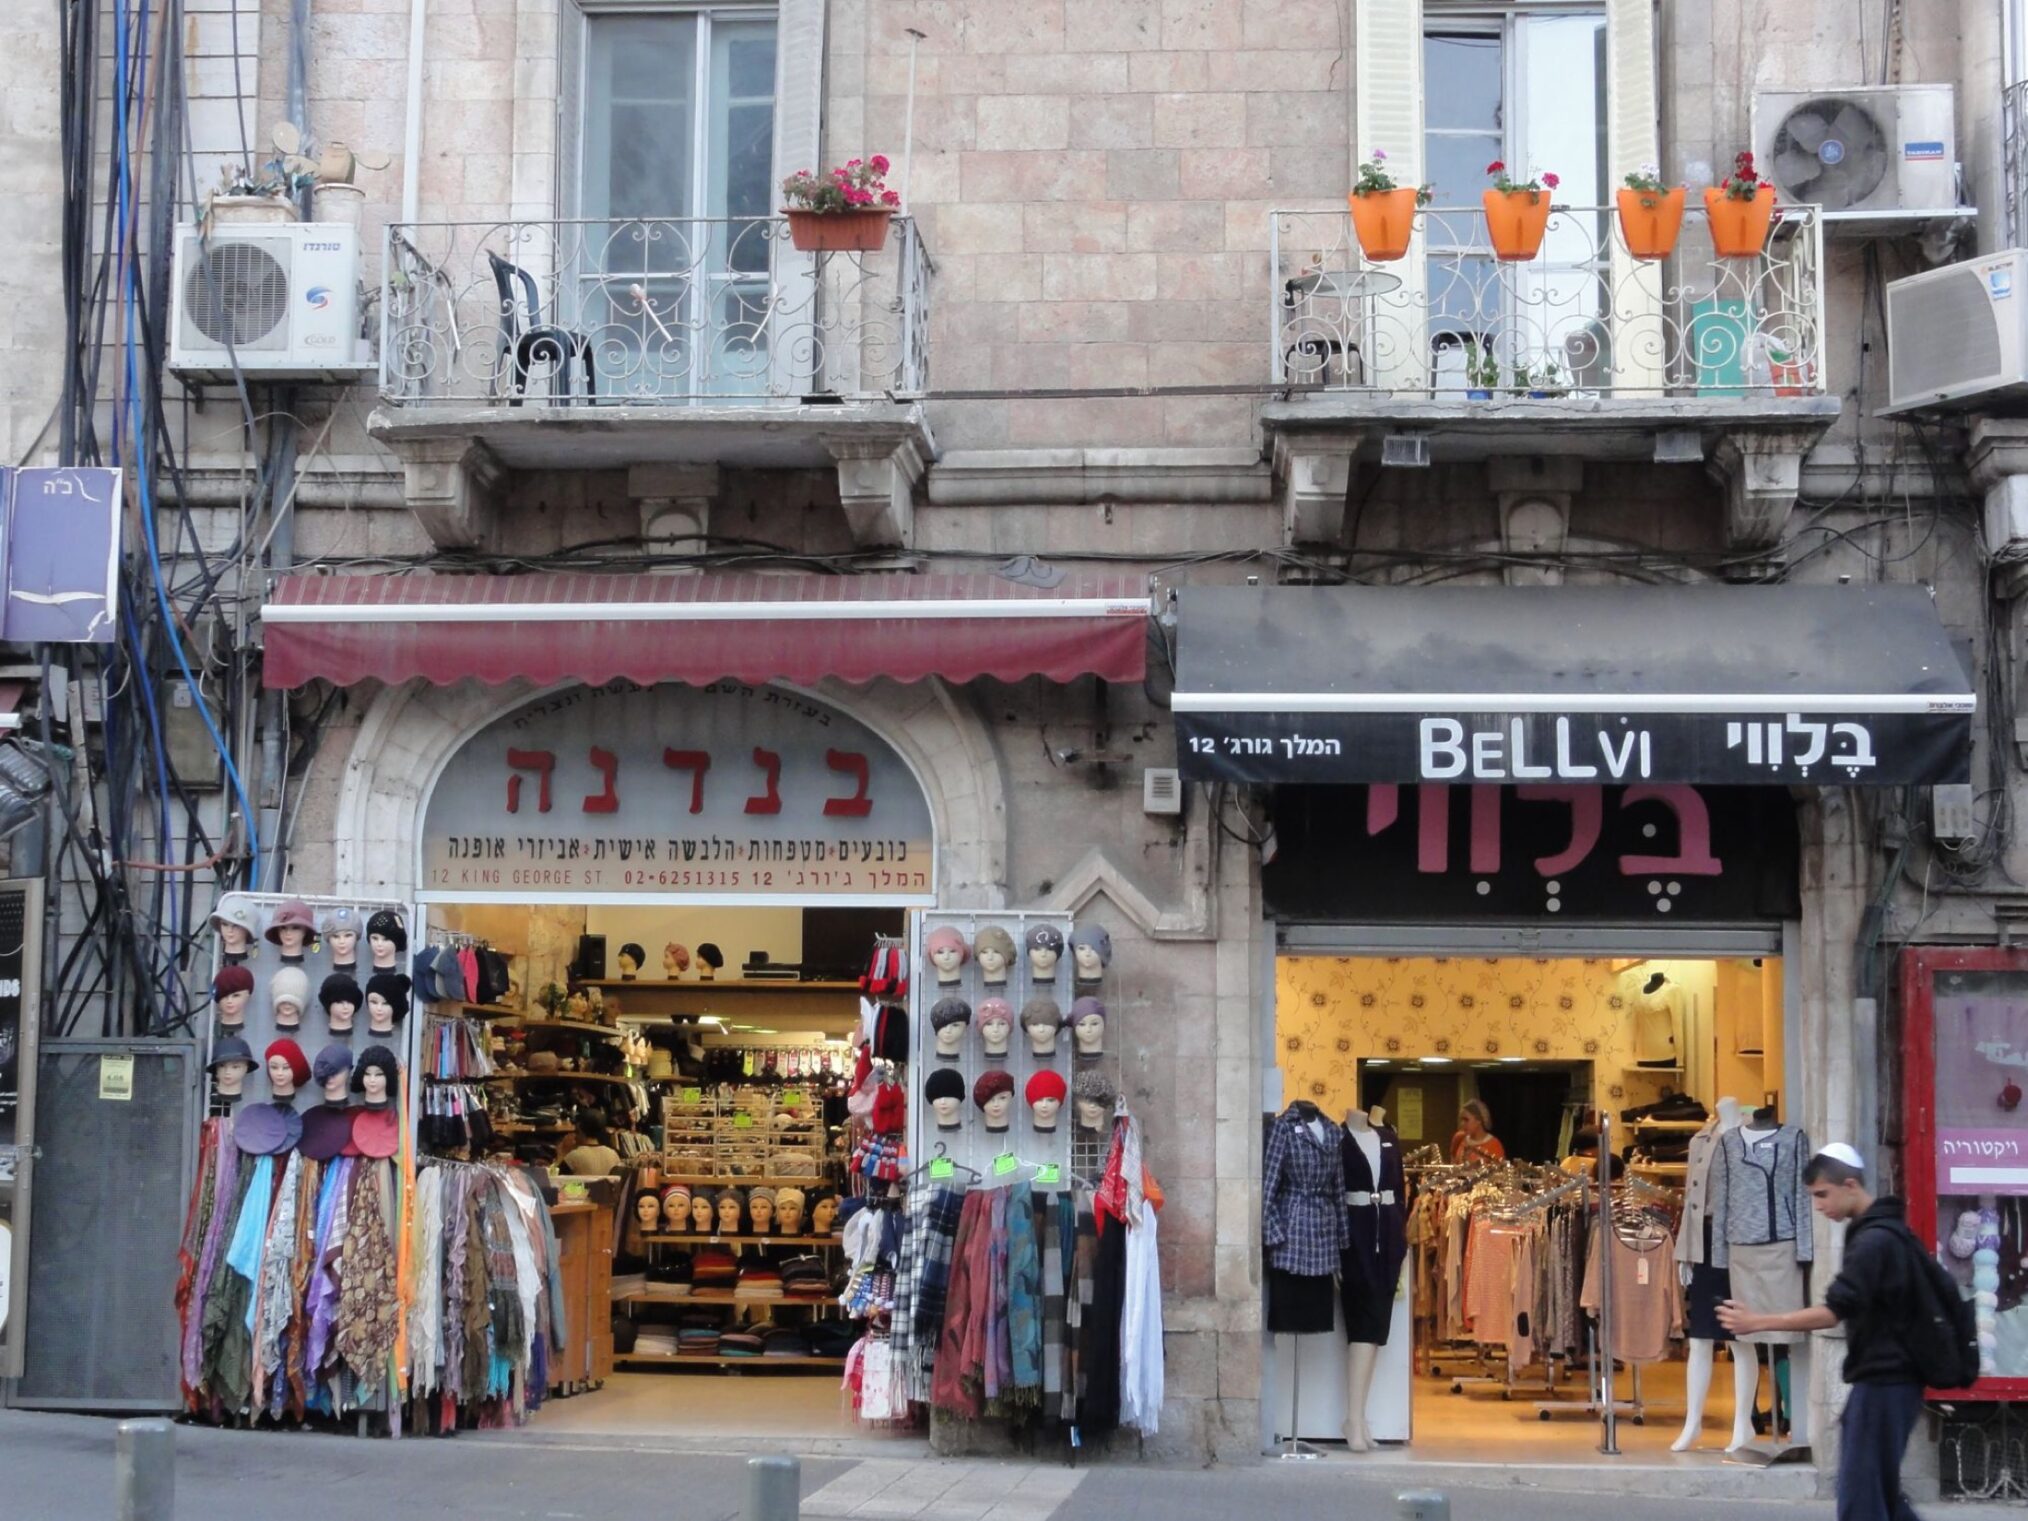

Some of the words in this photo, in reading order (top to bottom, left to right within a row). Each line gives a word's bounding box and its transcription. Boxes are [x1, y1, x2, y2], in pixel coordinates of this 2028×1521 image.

[1189, 737, 1215, 753] 12
[1280, 734, 1341, 759] המלך
[506, 746, 874, 817] בנדנה
[448, 837, 505, 860] אופנה
[518, 837, 580, 860] אביזרי
[592, 837, 656, 861] אישית
[668, 834, 735, 862] הלבשה
[748, 838, 826, 862] מטפחות
[838, 838, 907, 862] כובעים
[432, 869, 449, 883] 12
[461, 869, 500, 884] KING
[513, 869, 572, 885] GEORGE
[752, 871, 773, 886] 12
[868, 869, 926, 889] המלך
[1943, 1140, 2019, 1160] ויקטוריה
